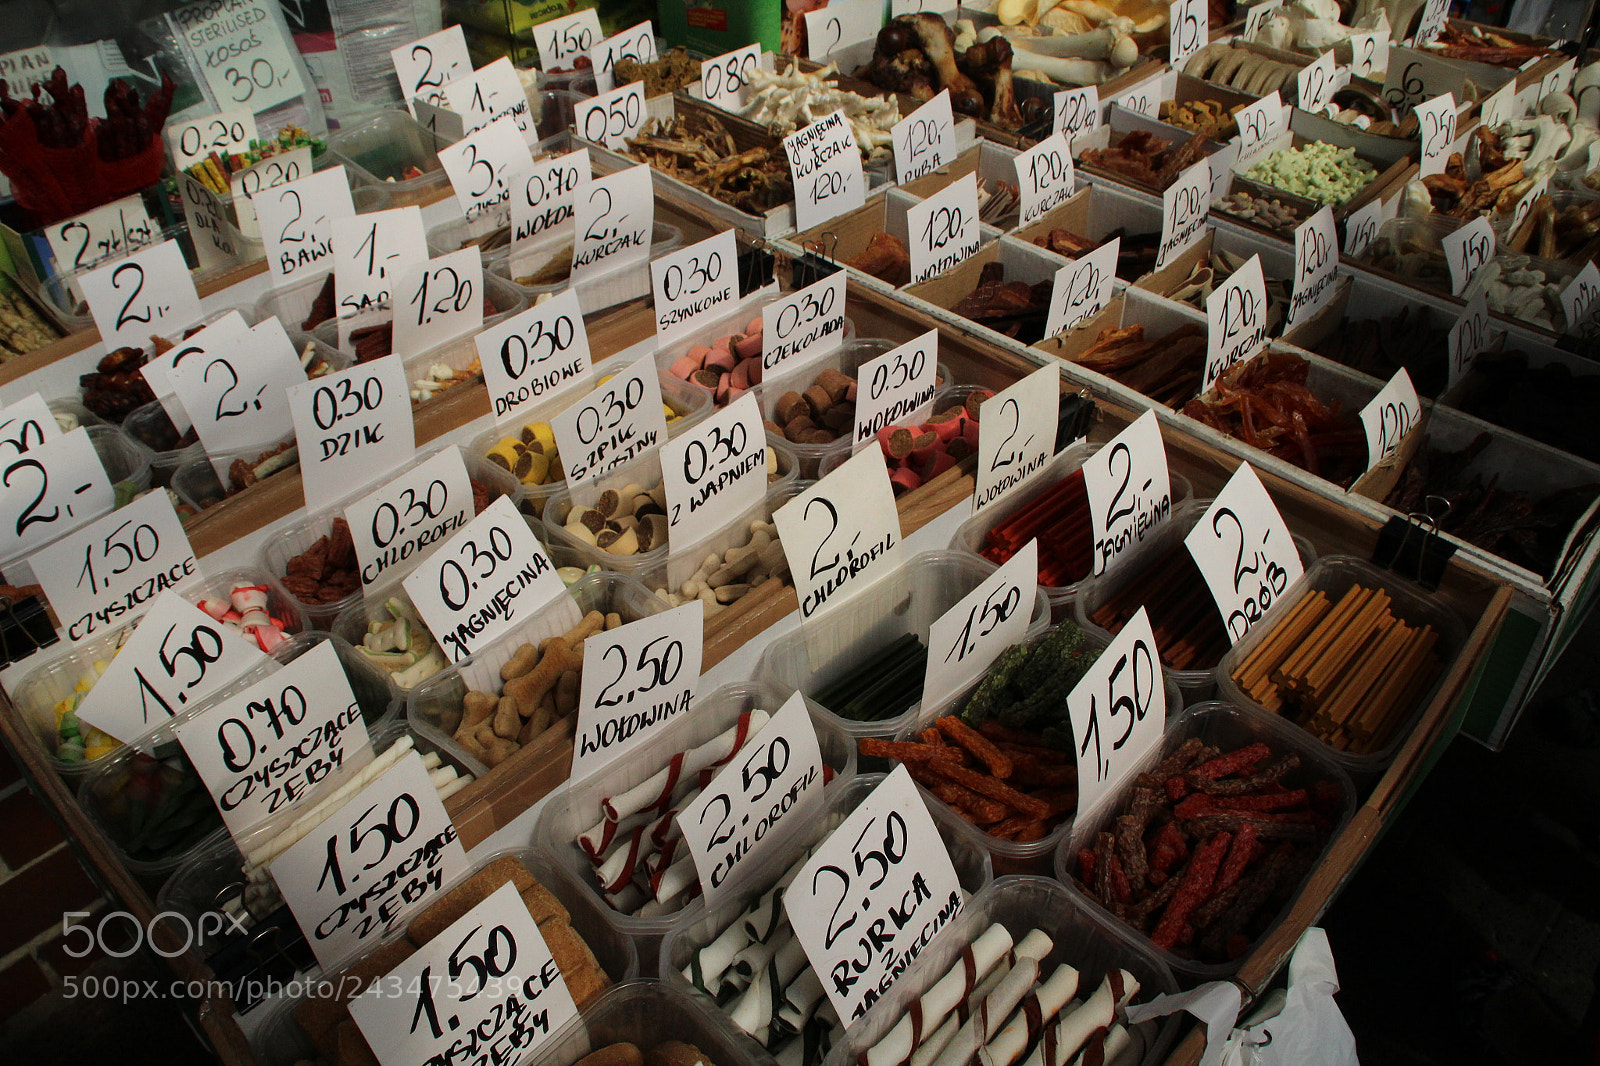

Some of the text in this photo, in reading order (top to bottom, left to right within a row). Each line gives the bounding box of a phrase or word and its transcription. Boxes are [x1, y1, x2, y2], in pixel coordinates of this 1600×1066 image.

[181, 121, 245, 157] 0.20
[796, 135, 852, 179] KURCZAK
[526, 167, 578, 206] 0.70
[1025, 187, 1073, 222] KURCZAK
[573, 230, 646, 270] KURCZAK
[664, 252, 722, 301] 0.30
[410, 267, 472, 326] 1.20
[660, 287, 731, 330] SZYNKOWE
[776, 287, 835, 339] 0.30
[501, 315, 574, 380] 0.30
[764, 316, 844, 369] CZEKOLADA
[313, 377, 383, 430] 0.30
[495, 358, 585, 416] DROBIOWE
[871, 350, 925, 399] 0.30
[577, 378, 644, 444] 0.30
[320, 423, 384, 462] DZIK
[684, 422, 746, 485] 0.30
[690, 448, 764, 512] WAPNIEM
[976, 452, 1048, 510] WOŁOWINA
[372, 480, 448, 548] 0.30
[362, 510, 467, 584] CHLOROFIL
[440, 527, 512, 611] 0.30
[802, 533, 895, 618] CHLOROFIL
[218, 685, 306, 773] 0.70
[711, 766, 818, 888] CHLOROFIL
[831, 872, 932, 997] RURKA
